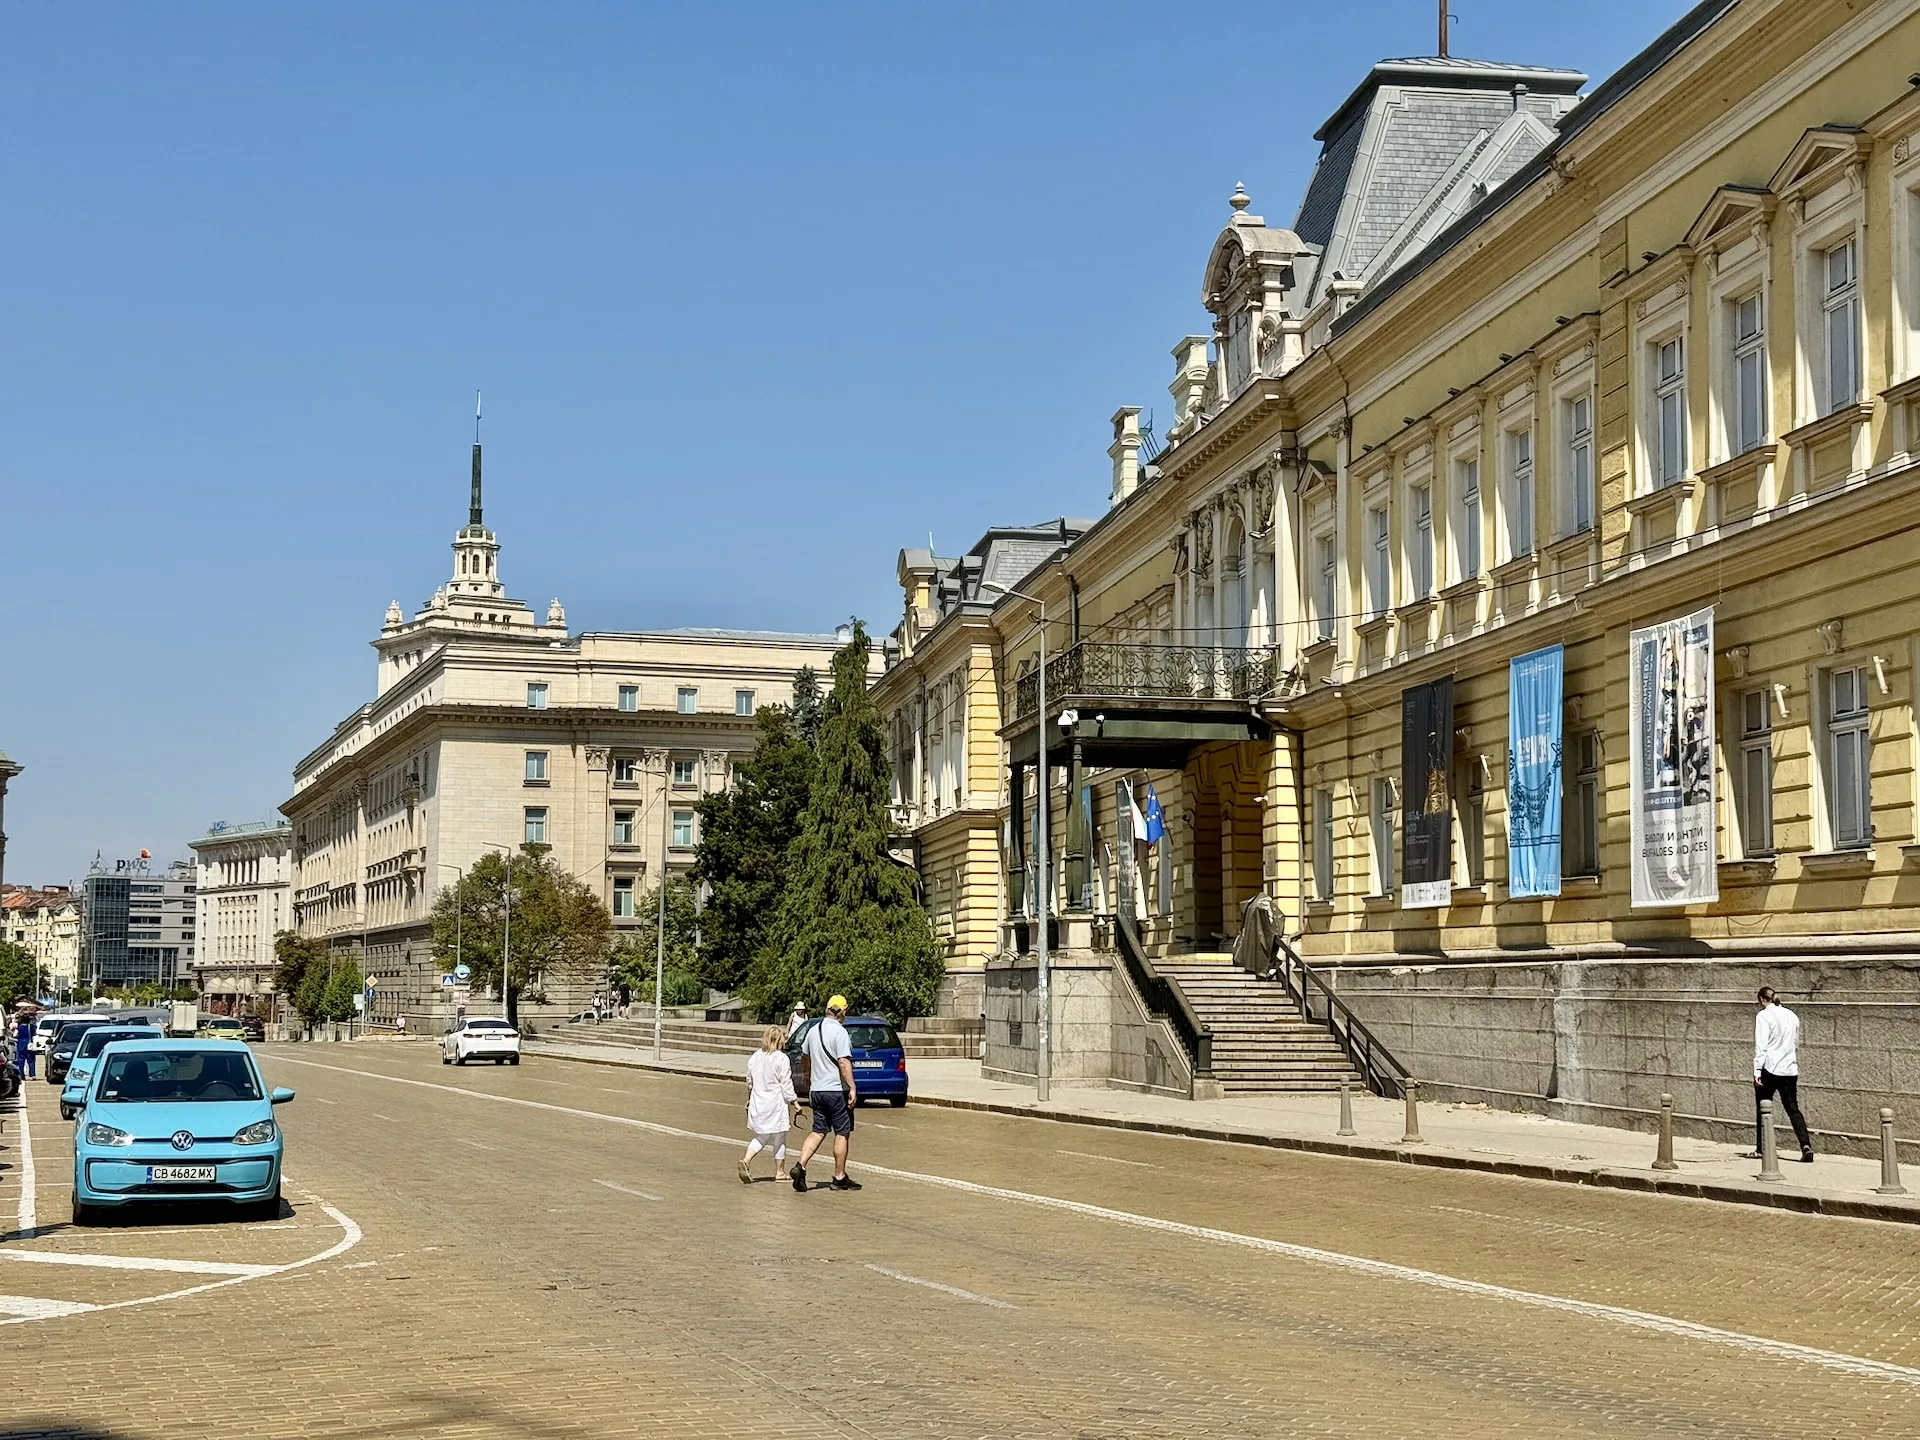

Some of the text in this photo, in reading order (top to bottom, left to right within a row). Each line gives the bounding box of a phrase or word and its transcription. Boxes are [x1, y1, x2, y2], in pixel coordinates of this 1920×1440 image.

[117, 859, 148, 871] pwc
[154, 1168, 213, 1179] CB 4682 MX
